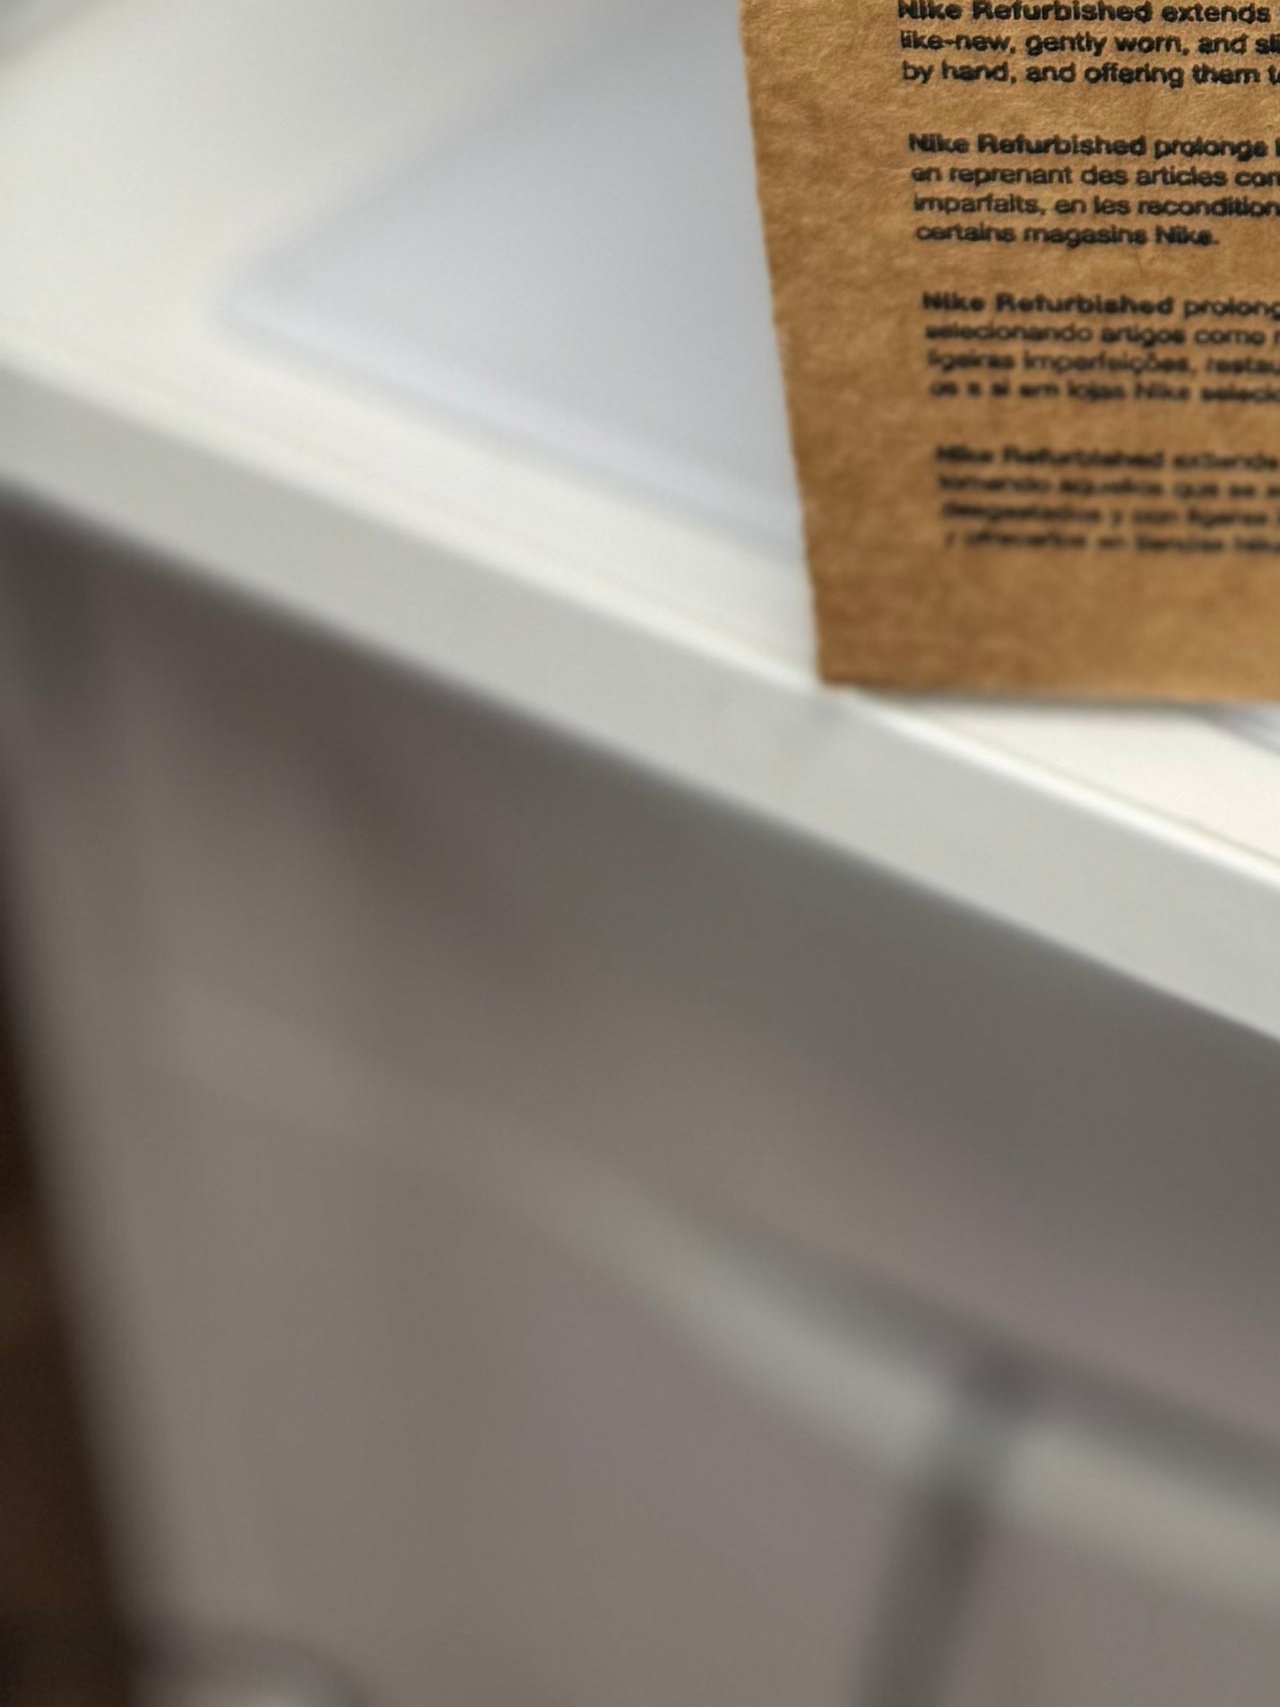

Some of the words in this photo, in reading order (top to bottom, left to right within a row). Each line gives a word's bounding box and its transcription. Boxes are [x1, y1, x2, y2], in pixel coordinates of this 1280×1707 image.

[1159, 2, 1272, 26] extends
[899, 29, 1017, 55] like-new,
[1024, 30, 1108, 58] gently
[1113, 35, 1190, 57] worn,
[1196, 33, 1250, 56] and
[901, 60, 935, 86] by
[940, 59, 1018, 85] hand,
[1023, 61, 1077, 85] and
[1083, 61, 1185, 91] offering
[1191, 62, 1262, 86] them
[907, 132, 971, 155] Nike
[976, 133, 1148, 158] Refurbished
[1153, 135, 1269, 164] prolonge
[910, 166, 944, 184] en
[948, 165, 1074, 190] reprenant
[1079, 164, 1130, 188] des
[1134, 165, 1229, 189] articles
[912, 192, 1047, 217] imparfaits,
[1052, 198, 1088, 216] en
[1091, 194, 1132, 219] les
[913, 221, 1018, 245] certains
[1021, 224, 1150, 252] magasins
[1154, 224, 1220, 248] Nike.
